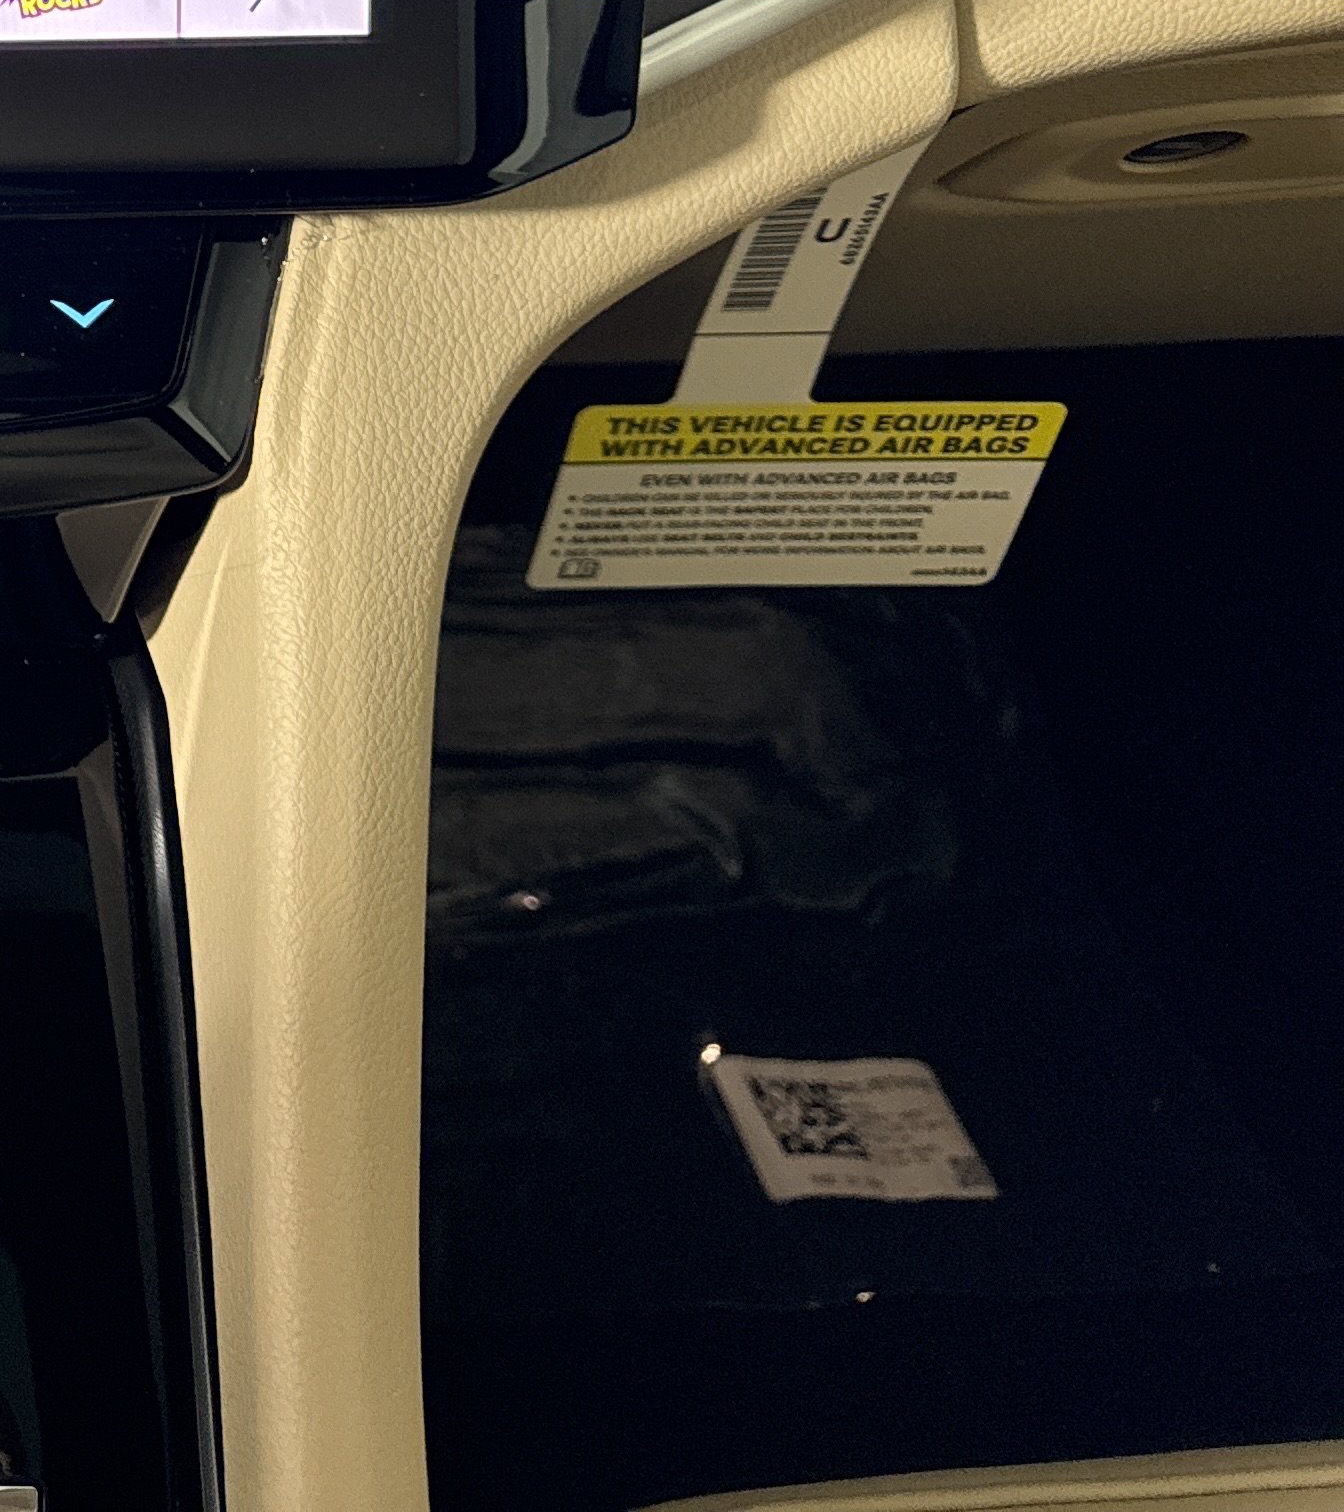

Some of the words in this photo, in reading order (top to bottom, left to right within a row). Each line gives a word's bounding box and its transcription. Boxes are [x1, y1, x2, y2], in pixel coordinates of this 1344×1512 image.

[607, 416, 682, 435] THIS
[690, 415, 827, 434] VEHICLE
[833, 414, 865, 432] IS
[873, 414, 1039, 432] EQUIPPED
[600, 439, 684, 457] WITH
[690, 437, 871, 456] ADVANCED
[876, 437, 933, 454] AIR
[940, 436, 1030, 454] BAGS
[639, 473, 692, 487] EVEN
[699, 472, 748, 486] WITH
[751, 471, 860, 486] ADVANCED
[863, 471, 899, 484] AIR
[903, 471, 957, 484] BAGS
